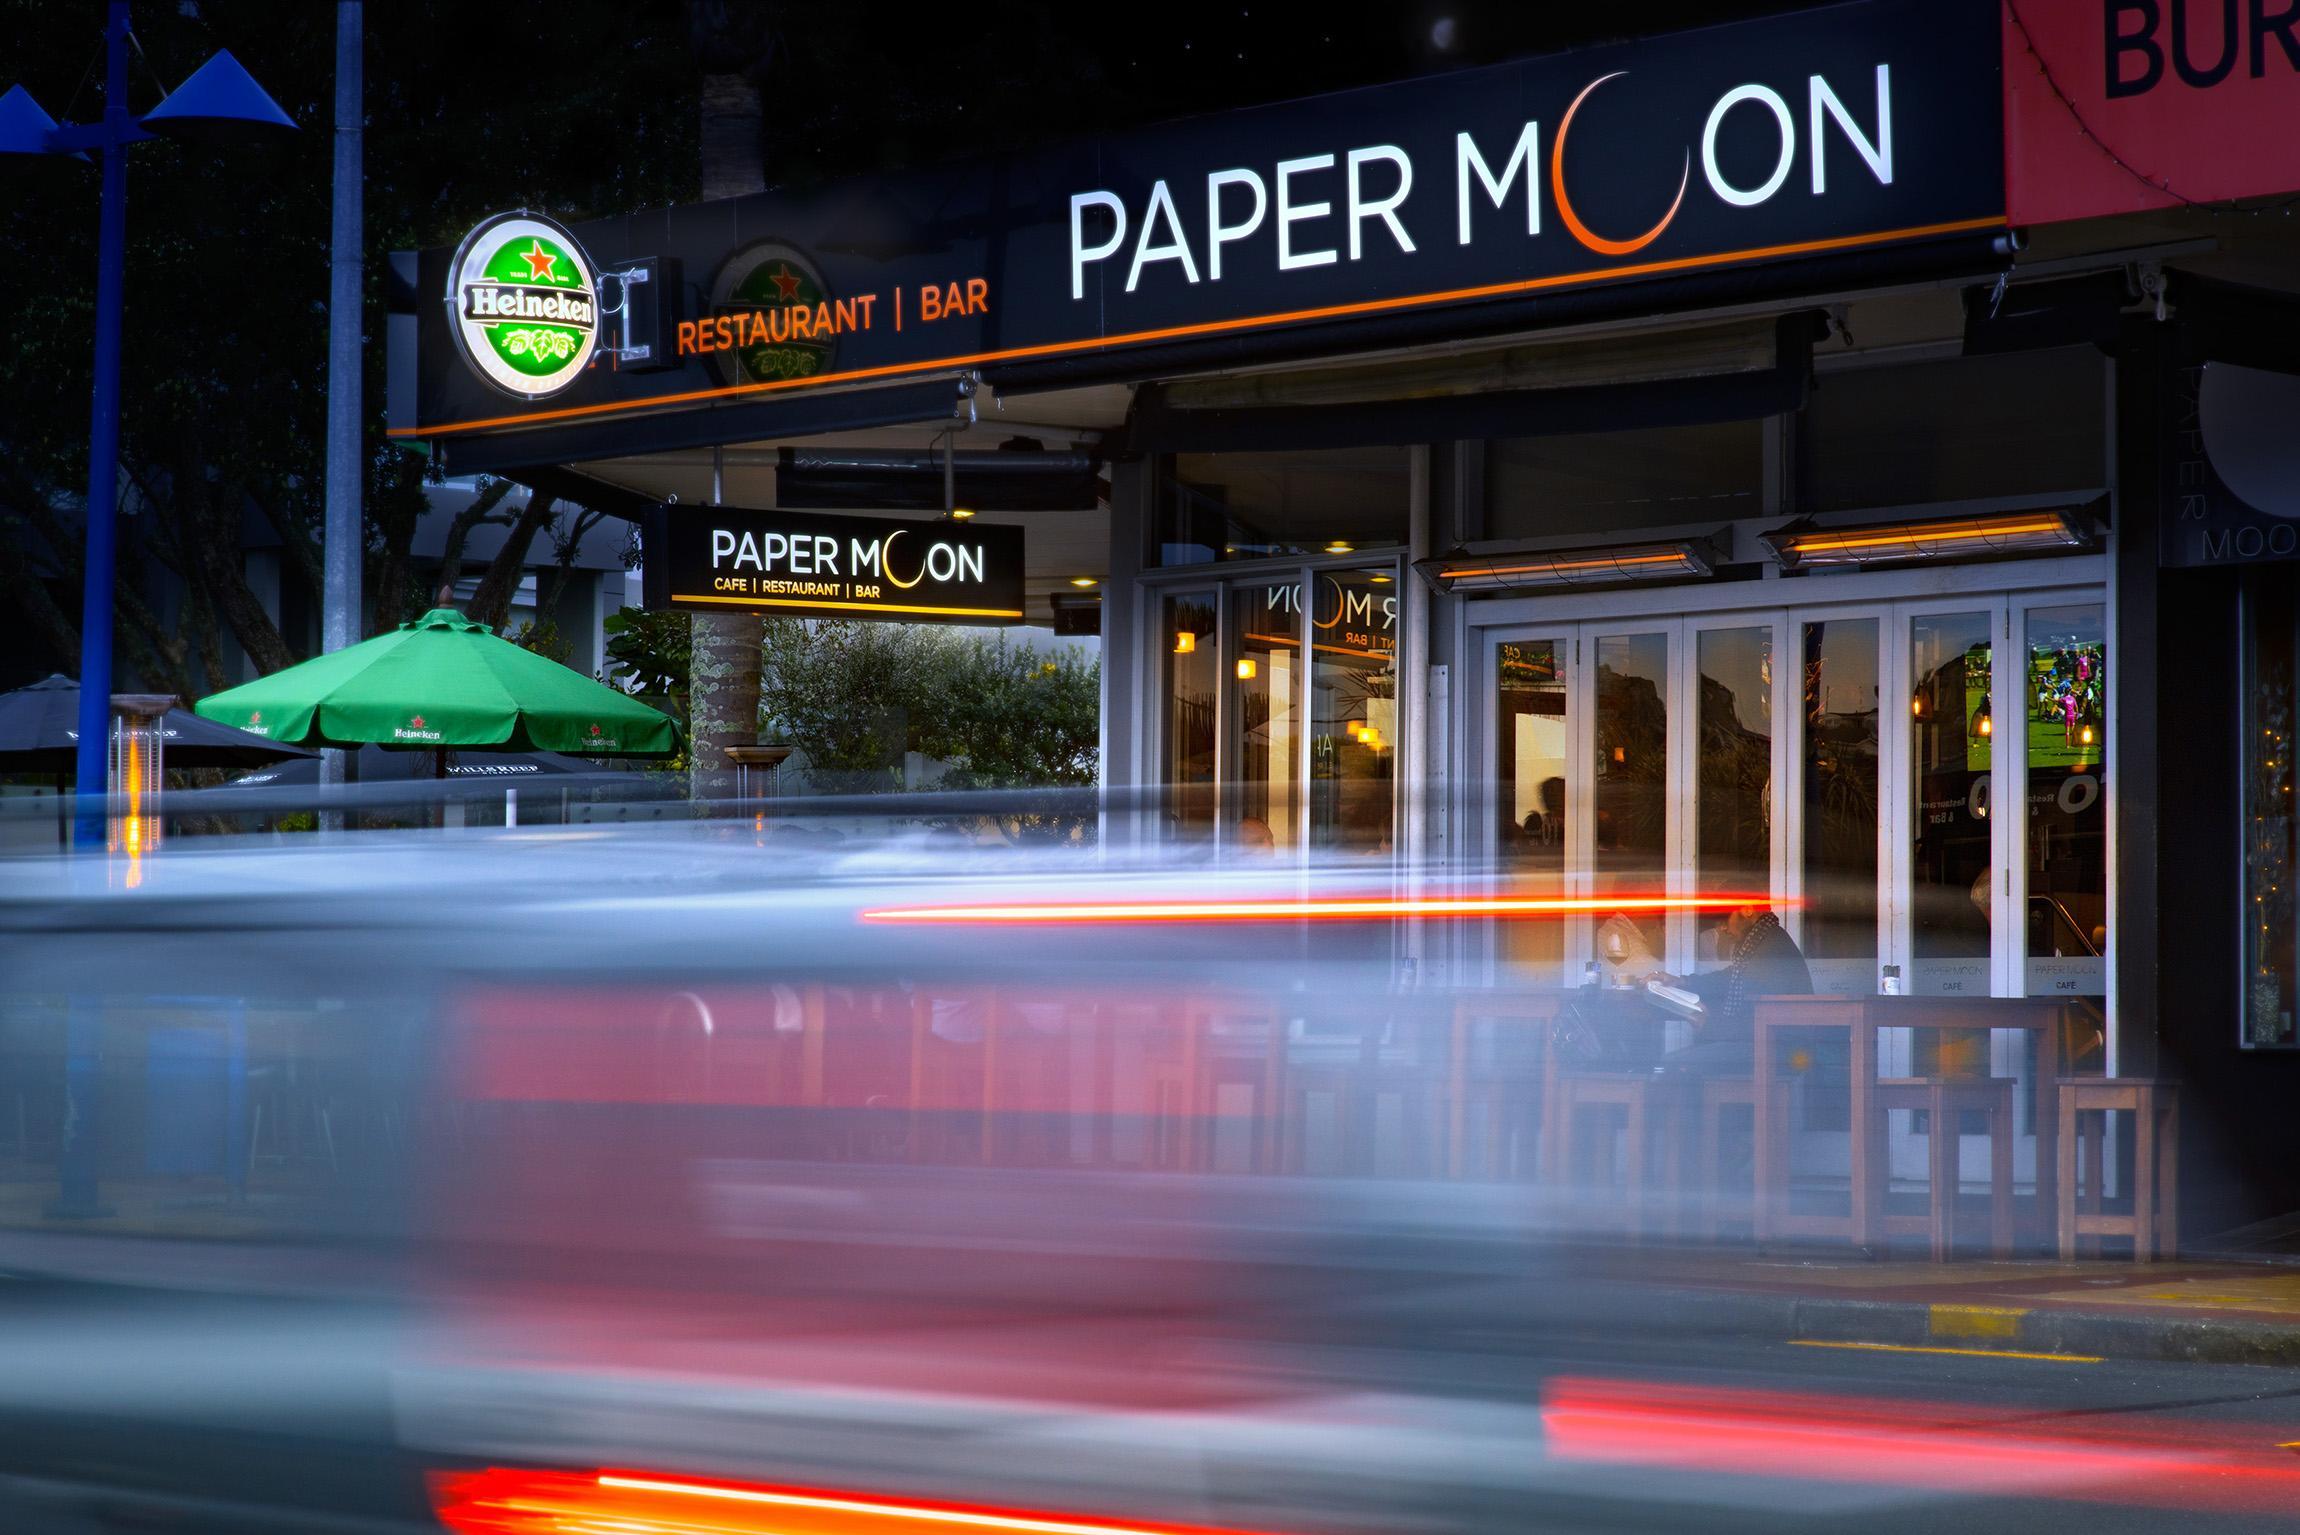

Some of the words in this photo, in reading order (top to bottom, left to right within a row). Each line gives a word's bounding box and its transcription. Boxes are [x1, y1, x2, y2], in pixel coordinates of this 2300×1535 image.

[2104, 0, 2300, 99] BUR
[1070, 144, 1417, 301] PAPER
[471, 287, 593, 324] Heineken
[676, 293, 878, 356] RESTAURANT
[920, 277, 991, 323] BAR
[711, 529, 840, 576] PAPER
[2201, 523, 2298, 561] MOO
[714, 576, 748, 592] CAFE
[761, 579, 841, 597] RESTAURANT
[854, 585, 881, 599] BAR
[394, 727, 441, 740] Heineken
